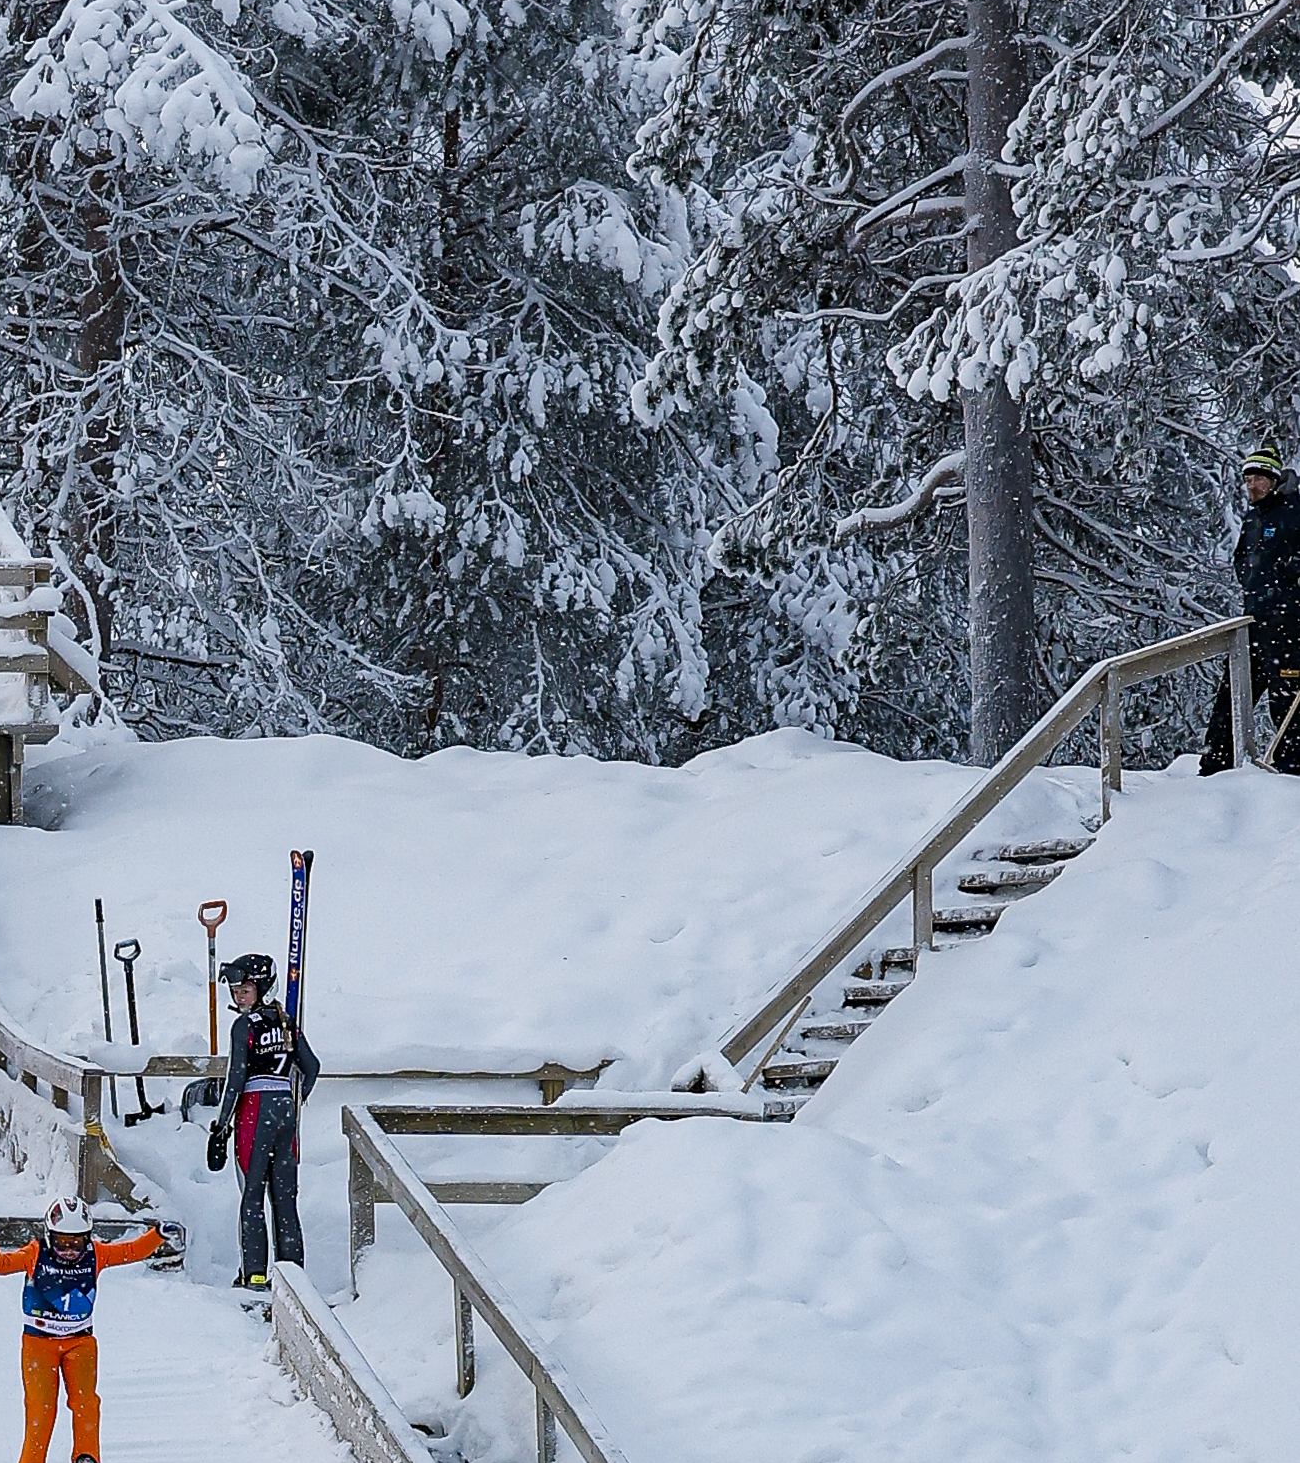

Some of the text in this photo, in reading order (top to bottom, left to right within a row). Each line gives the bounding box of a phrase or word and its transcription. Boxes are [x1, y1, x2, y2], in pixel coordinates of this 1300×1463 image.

[290, 879, 302, 963] Nuege.de
[273, 1054, 287, 1074] 7
[61, 1294, 70, 1311] 1
[43, 1311, 80, 1320] PLANICA
